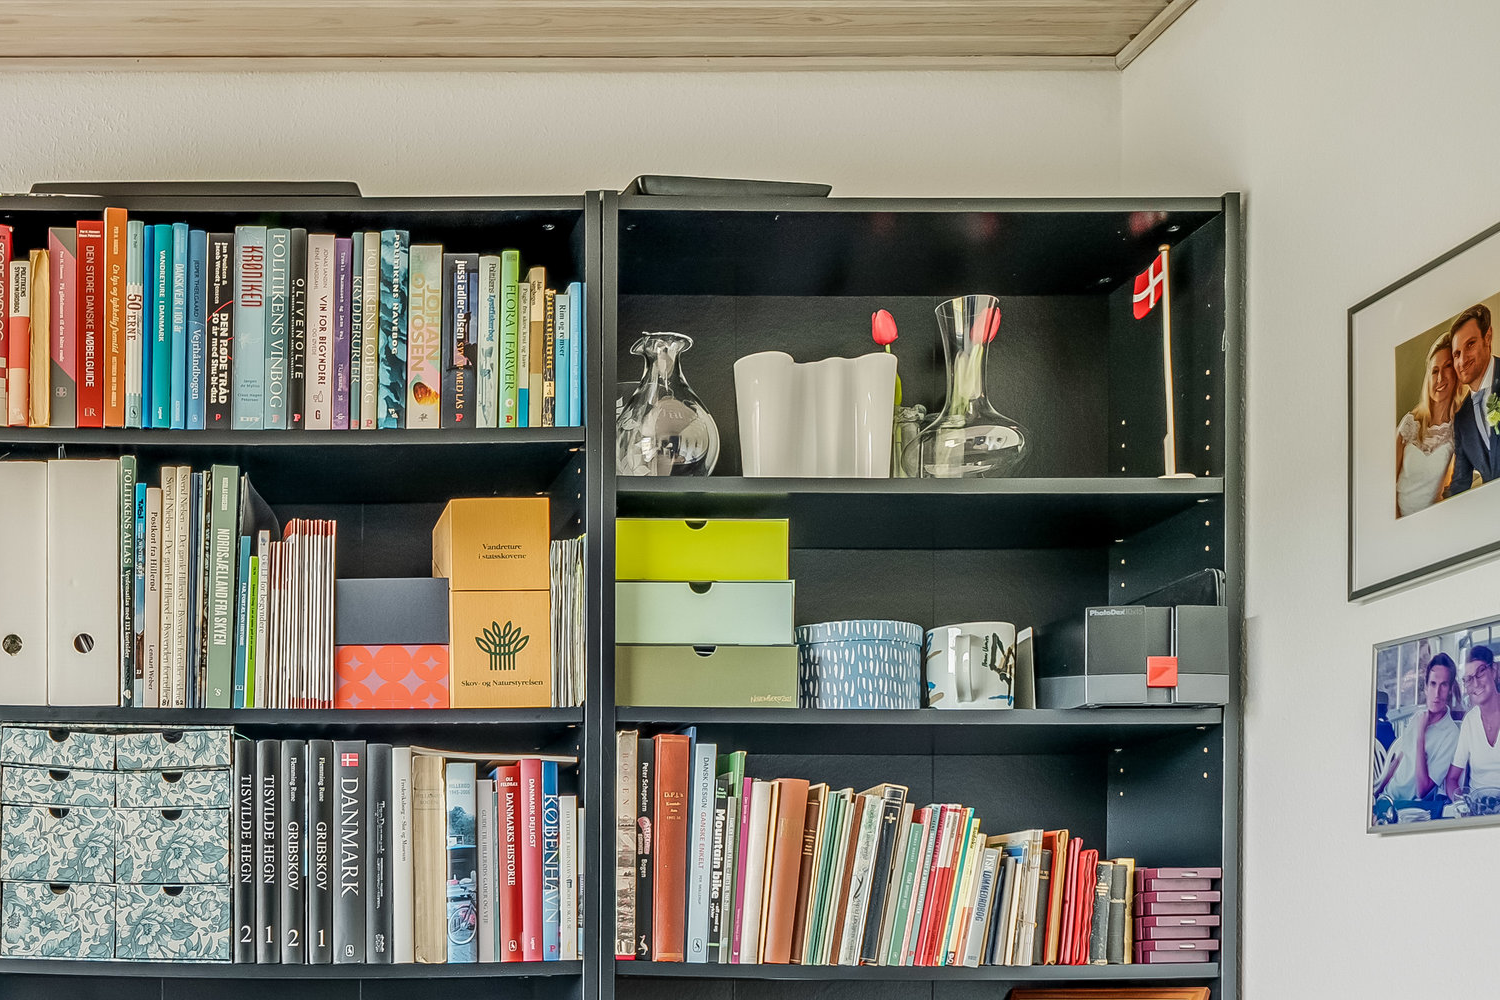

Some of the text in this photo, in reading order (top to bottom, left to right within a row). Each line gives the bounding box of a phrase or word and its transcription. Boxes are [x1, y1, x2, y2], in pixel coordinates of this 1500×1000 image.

[174, 264, 184, 287] DANSK
[174, 288, 183, 305] VEJR
[241, 246, 263, 307] KRØNIKEN
[455, 260, 467, 339] jussi adler-olsen
[86, 246, 94, 387] DEN STORE DANSKE MØBELGUIDE
[109, 264, 121, 354] En lys og lykkelig fremtid
[174, 311, 183, 324] 100
[211, 326, 219, 337] år
[212, 312, 218, 324] 50
[270, 234, 286, 408] POLITIKENS VINBOG
[294, 278, 304, 379] OLIVENOLIE
[351, 274, 363, 384] KRYDDERURTER
[364, 249, 376, 403] POLITIKENS LØBEBOG
[411, 272, 425, 371] OTTOSEN
[425, 284, 440, 360] JOHAN
[486, 295, 496, 342] Lystfiskerbog
[504, 284, 516, 391] FLORA FARVER
[558, 321, 565, 331] og
[190, 329, 202, 400] Vejrhåndbogen
[219, 313, 229, 404] DEN TRÅD
[318, 295, 327, 385] VIN FOR BEGYNDERE
[210, 359, 218, 403] Shu-bi-dua
[455, 371, 464, 409] MED LÅS
[179, 474, 187, 496] Svend
[179, 497, 187, 523] Nielsen
[123, 469, 132, 564] POLITIKENS ATLAS
[163, 476, 174, 615] Svend Nielsen Det Hillerød
[149, 512, 158, 592] Postkort fra Hillerød
[215, 528, 230, 598] NORDSJÆLLAND
[178, 572, 187, 600] Hillerød
[214, 599, 229, 616] FRA
[258, 594, 267, 634] begyndere
[213, 617, 228, 645] SKYEN
[622, 753, 630, 806] BOGEN
[640, 779, 649, 812] Schepelern
[241, 775, 251, 883] TISVILDE HEGN
[264, 775, 274, 884] TISVILDE HEGN
[288, 821, 299, 890] GRIBSKOV
[316, 821, 327, 890] GRIBSKOV
[341, 777, 359, 897] DANMARK
[506, 792, 516, 886] DANMARKS HISTORIE
[698, 843, 706, 869] ENKELT
[699, 812, 707, 841] GANSKE
[712, 809, 725, 870] Mountain
[969, 826, 978, 849] Sudoku
[544, 793, 559, 923] KØBENHAVN
[640, 859, 648, 878] Bogen
[711, 871, 722, 899] bike
[974, 869, 992, 922] LOMMEORDBOG
